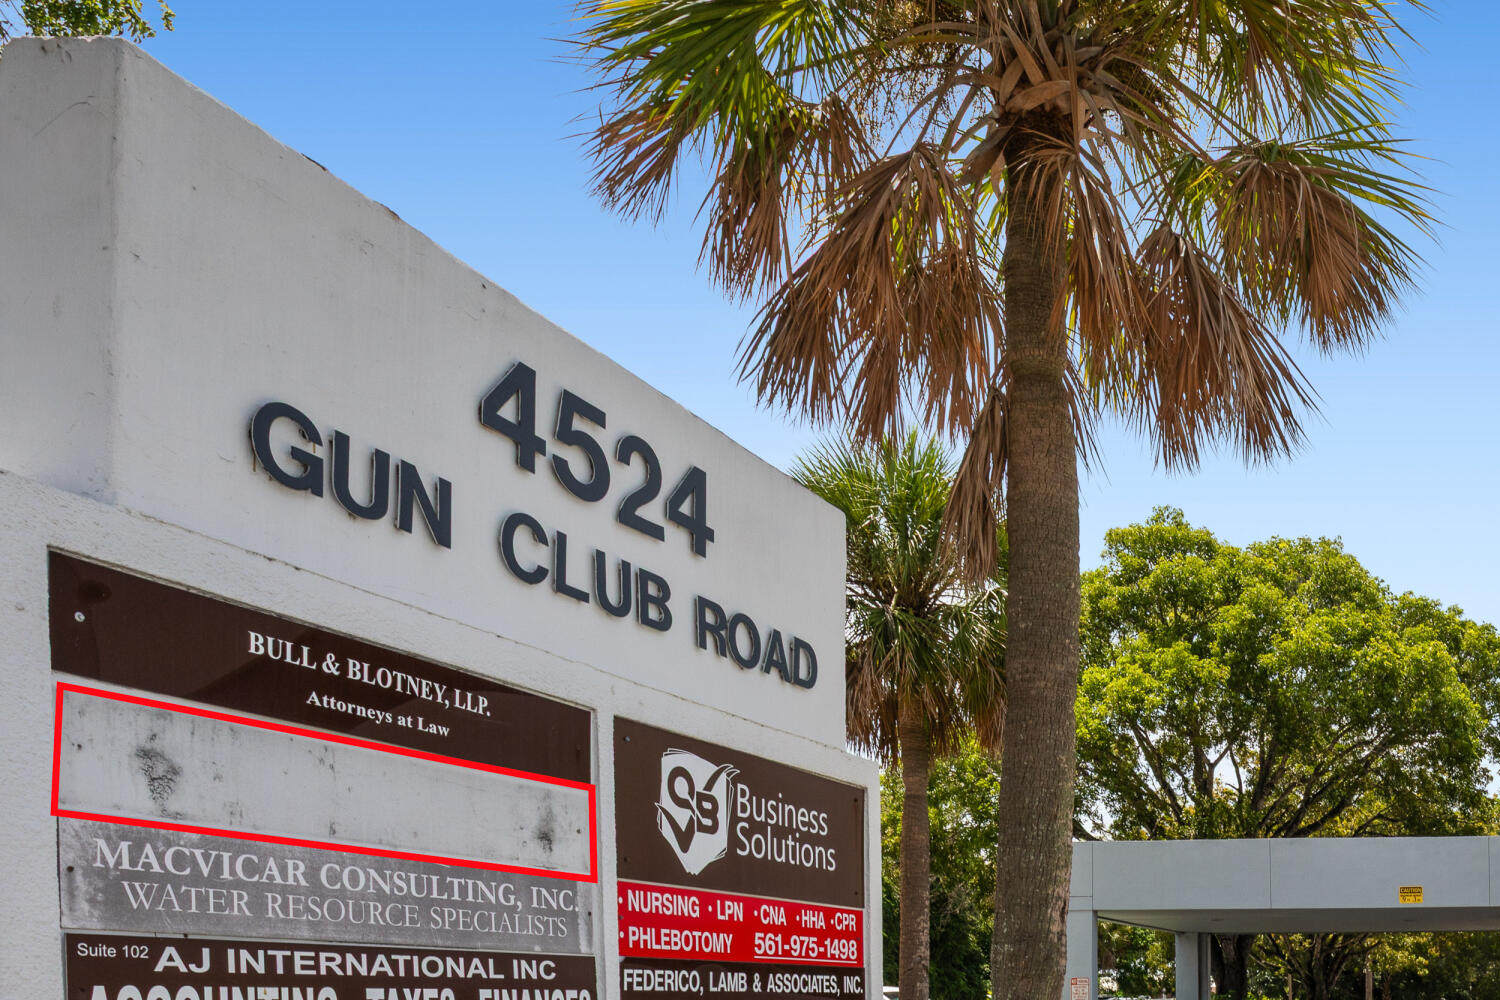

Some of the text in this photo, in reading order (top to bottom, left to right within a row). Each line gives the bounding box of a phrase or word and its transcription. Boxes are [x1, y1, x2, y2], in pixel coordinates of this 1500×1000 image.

[480, 361, 714, 558] 4524
[249, 402, 818, 690] GUN CLUB ROAD
[247, 630, 491, 717] BULL & BLOTNEY, LLP.
[306, 690, 450, 738] Attorneys at Law
[736, 783, 828, 836] Business
[736, 821, 837, 872] Solutions
[92, 838, 580, 913] MACVICAR CONSULTING, INC.
[120, 881, 568, 938] WATER RESOURCE SPECIALISTS
[627, 889, 857, 932] NURSING LPN CNA HHA CPR
[77, 942, 149, 959] Suite 102
[153, 946, 557, 981] AJ INTERNATIONAL INC
[628, 926, 858, 960] PHLEBOTOMY 561-975-1498
[623, 969, 864, 996] FEDERICO, LAMB & ASSOCIATES, INC.
